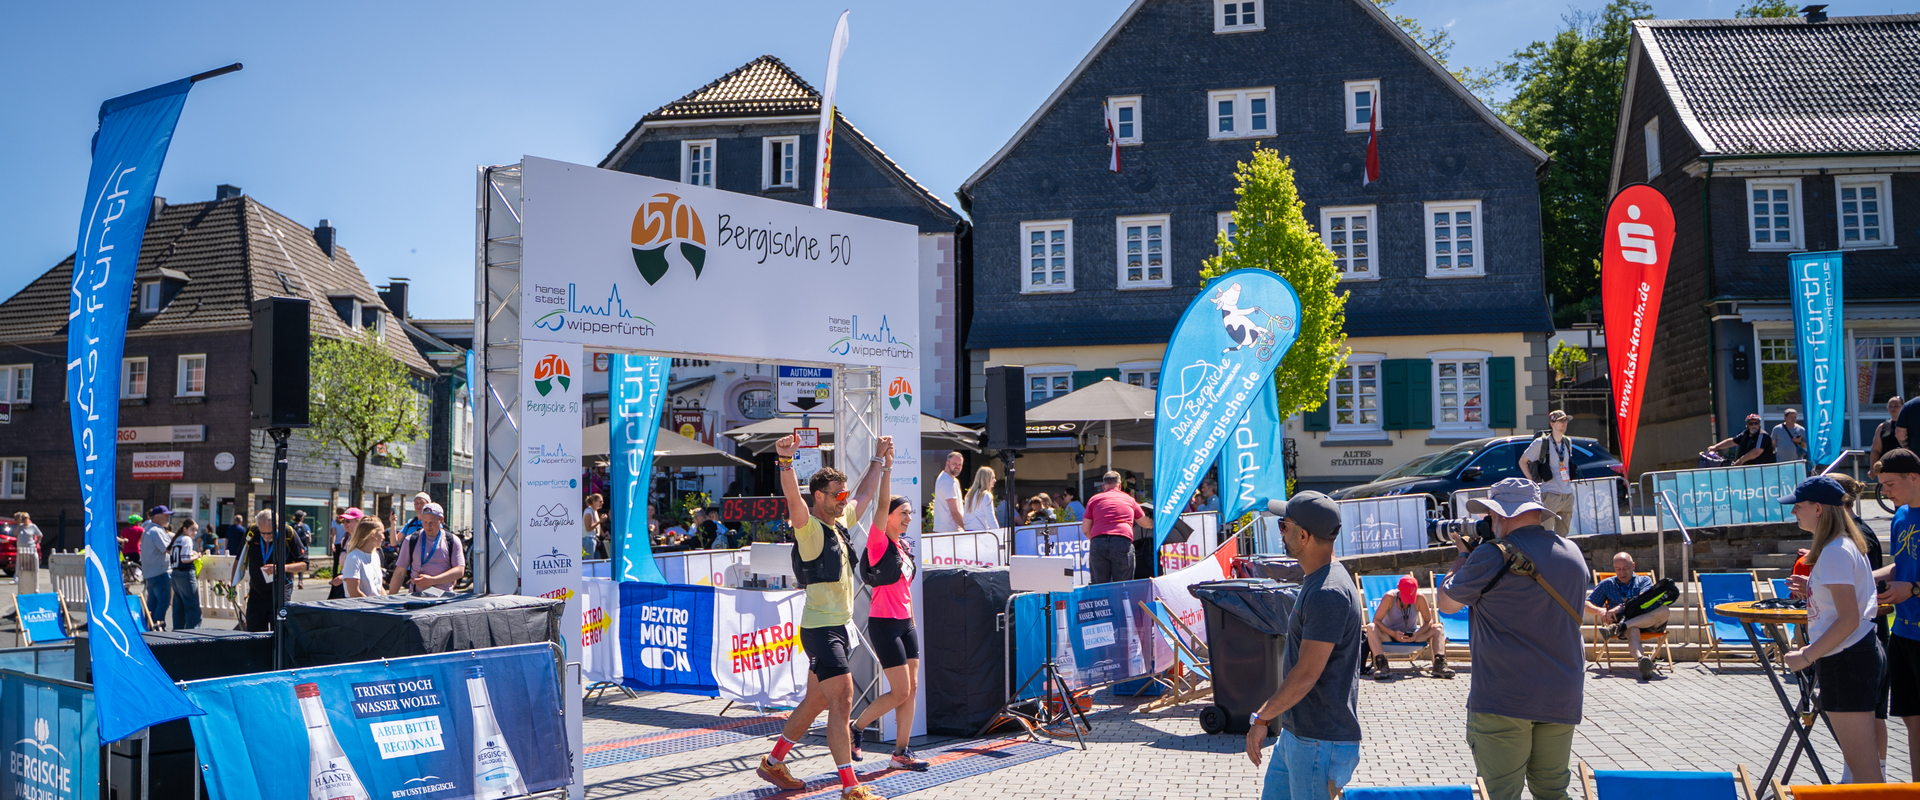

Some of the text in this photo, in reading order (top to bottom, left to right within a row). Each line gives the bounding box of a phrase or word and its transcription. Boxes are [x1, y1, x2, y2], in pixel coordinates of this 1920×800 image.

[717, 213, 851, 266] Bergische 50
[535, 283, 565, 295] hanse
[534, 295, 565, 305] stadt
[566, 318, 654, 336] wipperfürth
[829, 316, 850, 325] hanse
[828, 325, 850, 334] stadt
[851, 344, 913, 359] wipperfürth
[1619, 281, 1651, 418] www.ksk-koeln.de
[790, 368, 822, 377] AUTOMAT
[527, 399, 579, 417] Bergische 50
[1171, 358, 1231, 441] Das Bergische
[674, 414, 701, 424] Penne
[884, 412, 910, 427] Bergische
[117, 430, 137, 441] RGO
[1183, 409, 1210, 447] SCHWALBE
[1162, 371, 1260, 515] www.dasbergische.de
[1331, 458, 1384, 466] STADTHAUS
[1343, 450, 1372, 458] ALTES
[134, 460, 182, 468] WASSERFUHR
[527, 479, 569, 487] wipperfürth
[723, 499, 787, 520] 05:15:37
[529, 516, 575, 532] Das Bergische
[532, 558, 572, 570] HAANER
[23, 612, 57, 621] HAANER
[641, 605, 689, 625] DEXTRO
[640, 623, 688, 650] MODE
[732, 621, 793, 653] DEXTRO
[661, 649, 692, 672] ON
[733, 641, 794, 674] ENERGY
[355, 679, 434, 698] TRINKT DOCH
[356, 694, 440, 714] WASSER WOLLT.
[378, 719, 438, 737] ABER BITTE
[383, 736, 440, 754] REGIONAL.
[477, 750, 508, 762] BERGISCHE
[10, 750, 71, 793] BERGISCHE
[315, 773, 353, 788] HAANER
[318, 781, 352, 792] FELSENQUELLE
[392, 781, 457, 799] BEWUSST BERGISCH.
